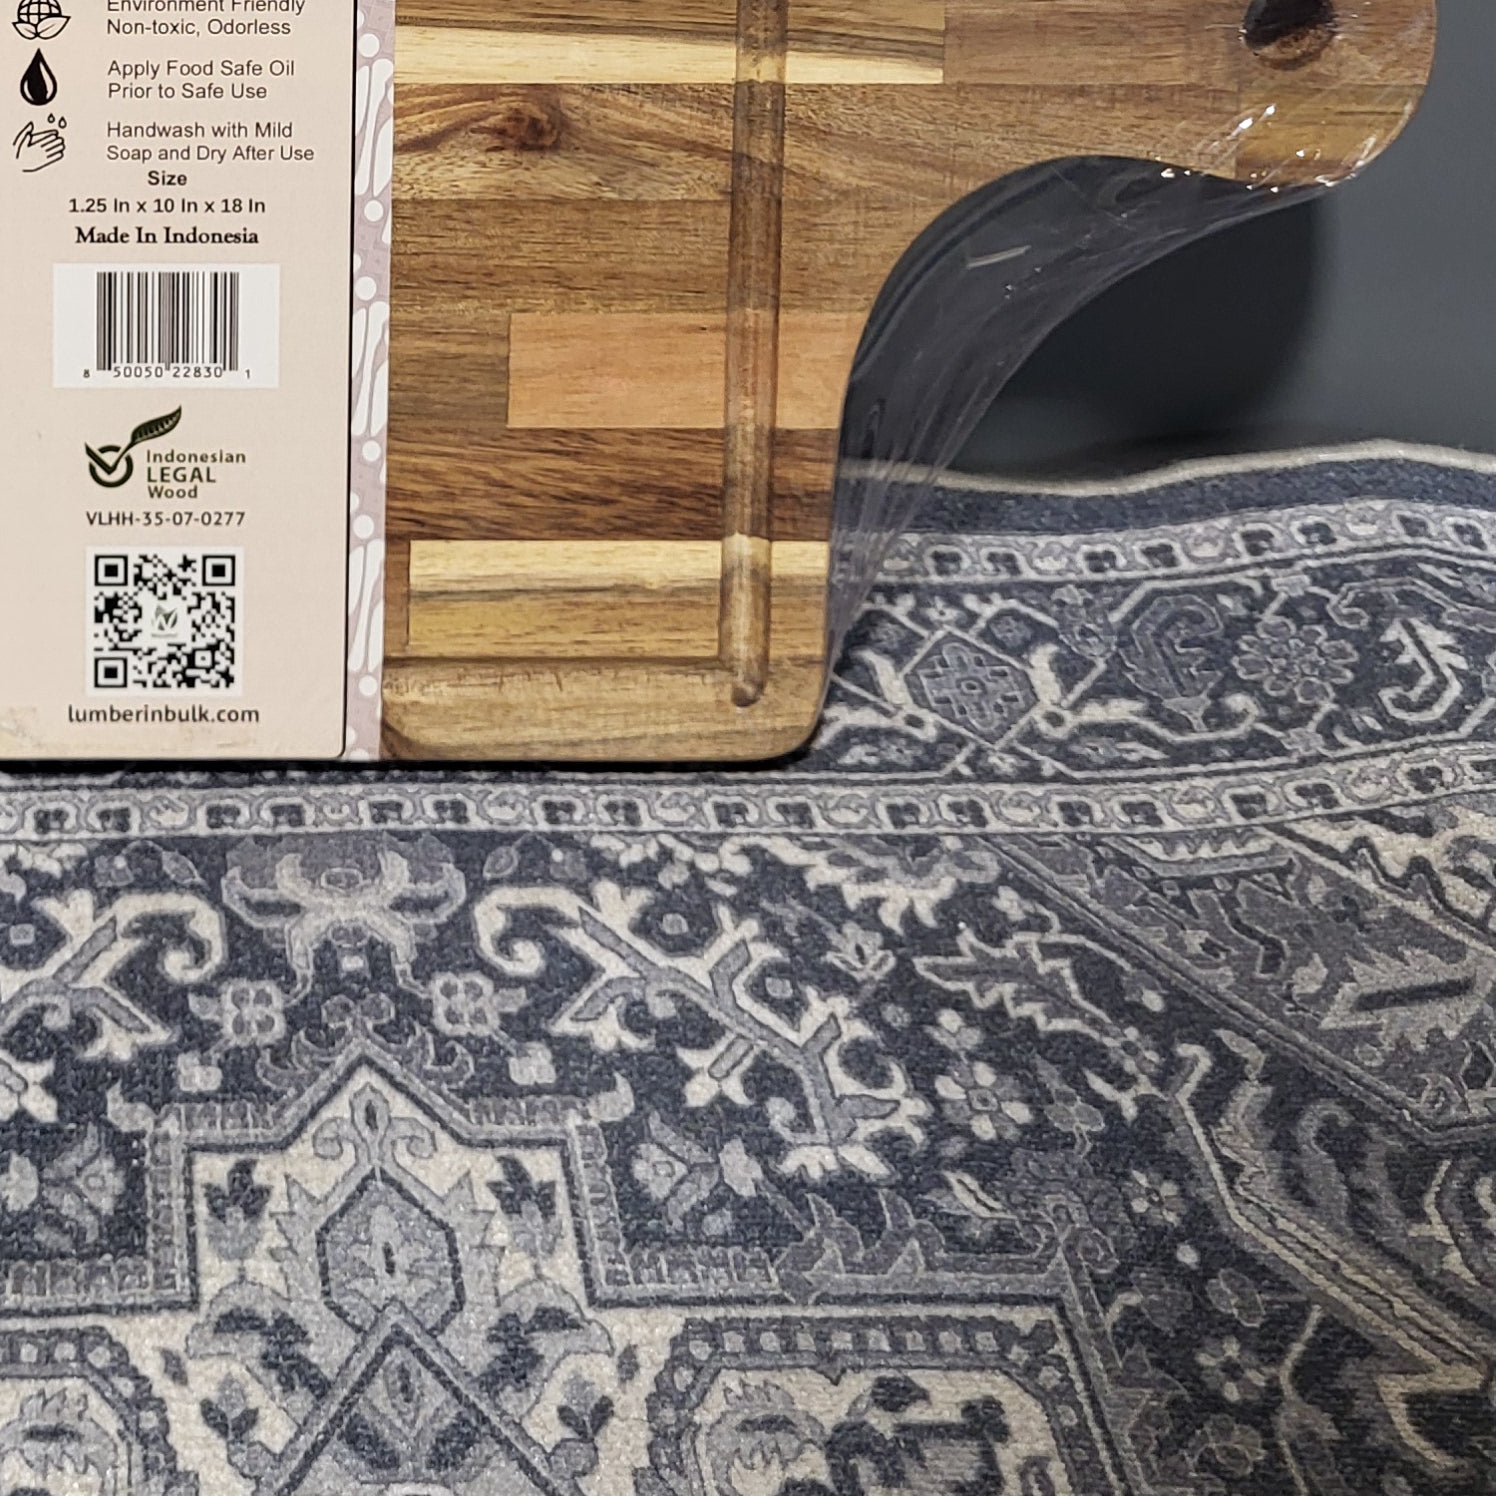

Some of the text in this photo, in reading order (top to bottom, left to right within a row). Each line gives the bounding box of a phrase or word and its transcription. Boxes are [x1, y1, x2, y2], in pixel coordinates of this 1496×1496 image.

[106, 17, 292, 38] Non-toxic, Odorless
[107, 59, 295, 81] Apply Food Safe Oil
[108, 82, 268, 99] Prior to Safe Use
[107, 121, 293, 139] Handwash with Mild
[106, 144, 315, 165] Soap and Dry After Use
[147, 169, 188, 187] Size
[69, 197, 266, 214] 1.25 In x 10 In x 18 In
[75, 225, 259, 244] Made In Indonesia
[82, 365, 251, 380] 8 50050 22830 1
[146, 448, 246, 464] Indonesian
[146, 466, 217, 484] LEGAL
[147, 484, 198, 499] Wood
[85, 510, 246, 527] VLHH-35-07-0277
[68, 703, 260, 724] lumberinbulk.com
